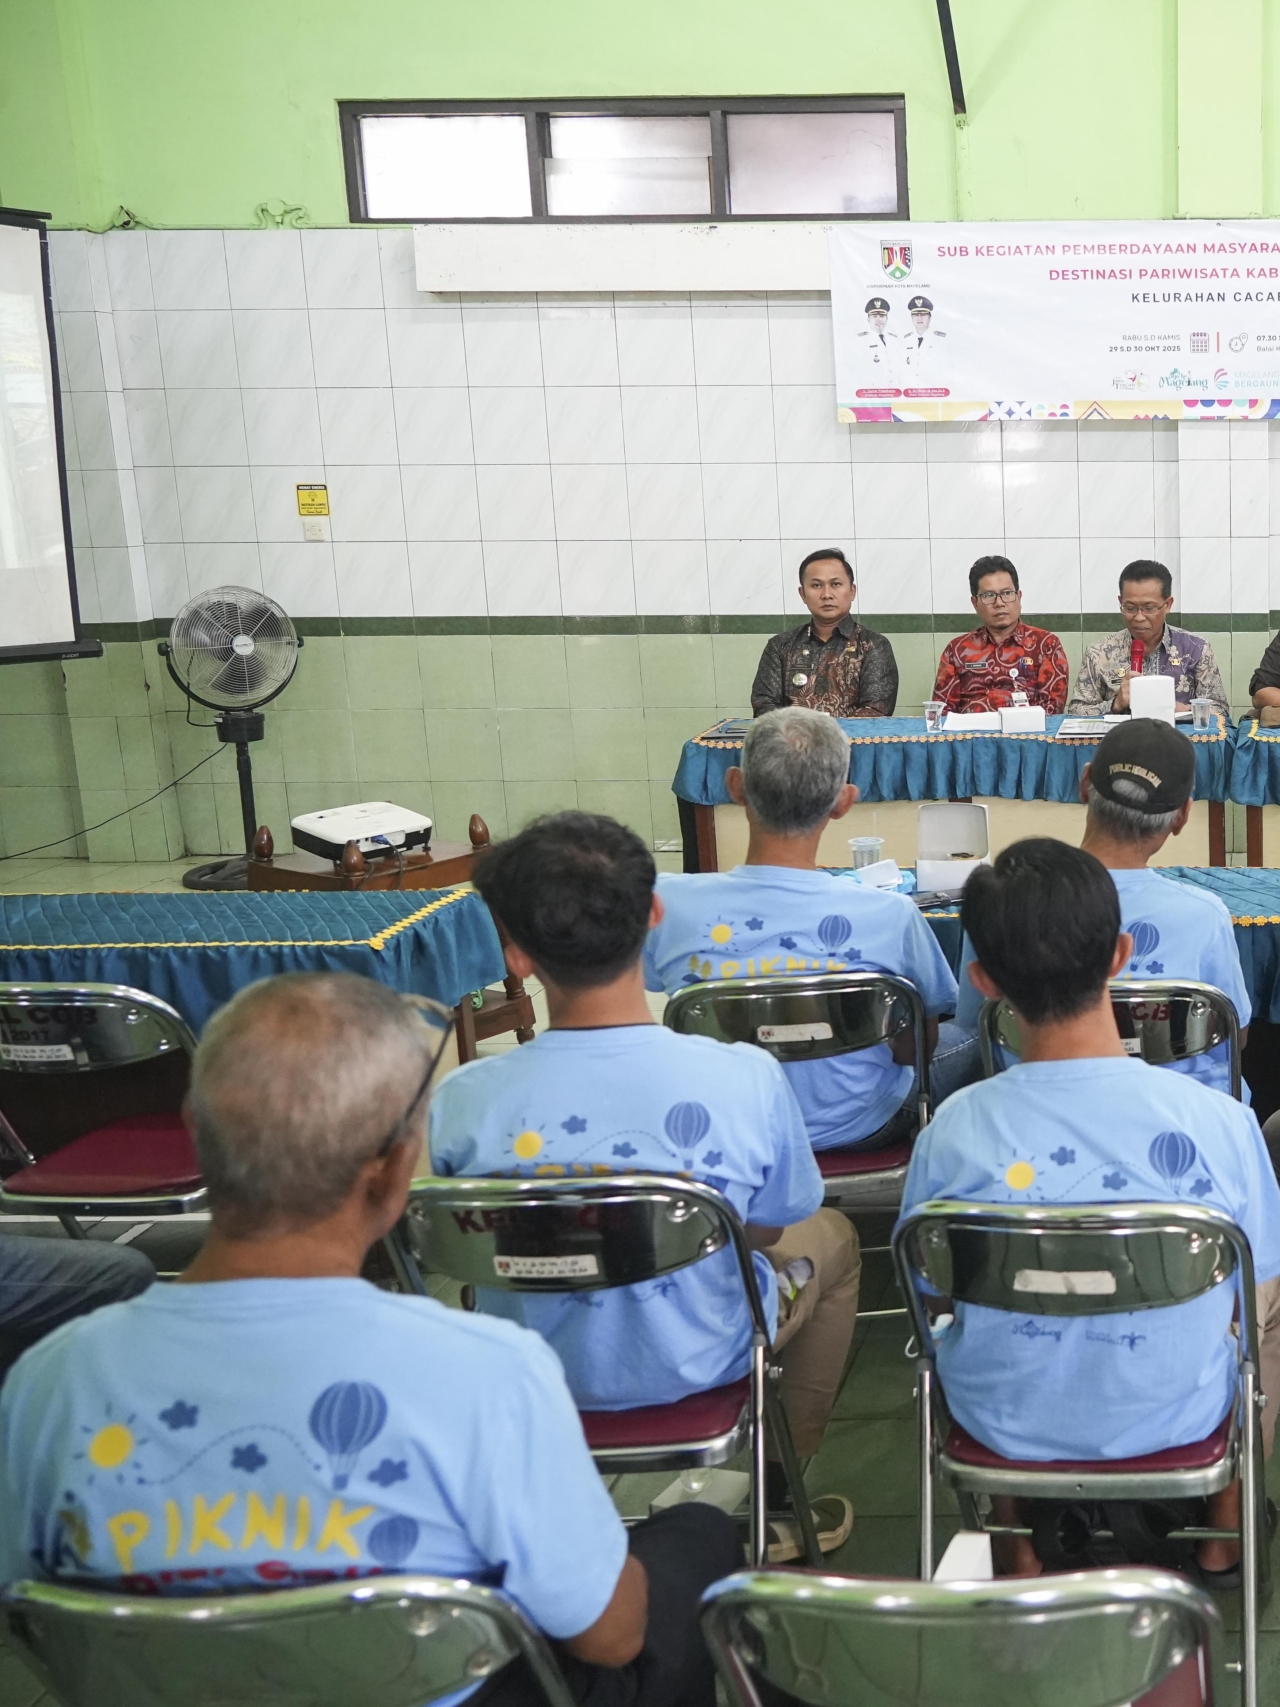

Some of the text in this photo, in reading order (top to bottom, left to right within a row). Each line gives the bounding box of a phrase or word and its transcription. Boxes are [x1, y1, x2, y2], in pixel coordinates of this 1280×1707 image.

[937, 246, 969, 257] SUB
[975, 245, 1056, 257] KEGIATAN
[1062, 243, 1197, 256] PEMBERDAYAAN
[1049, 269, 1133, 281] DESTINASI
[1138, 268, 1241, 280] PARIWISATA
[1131, 291, 1226, 303] KELURAHAN
[1158, 371, 1209, 391] Magelang
[1234, 371, 1280, 379] MAGELANG
[1108, 762, 1132, 775] PUBLIC
[106, 1492, 377, 1576] PIKNIK
